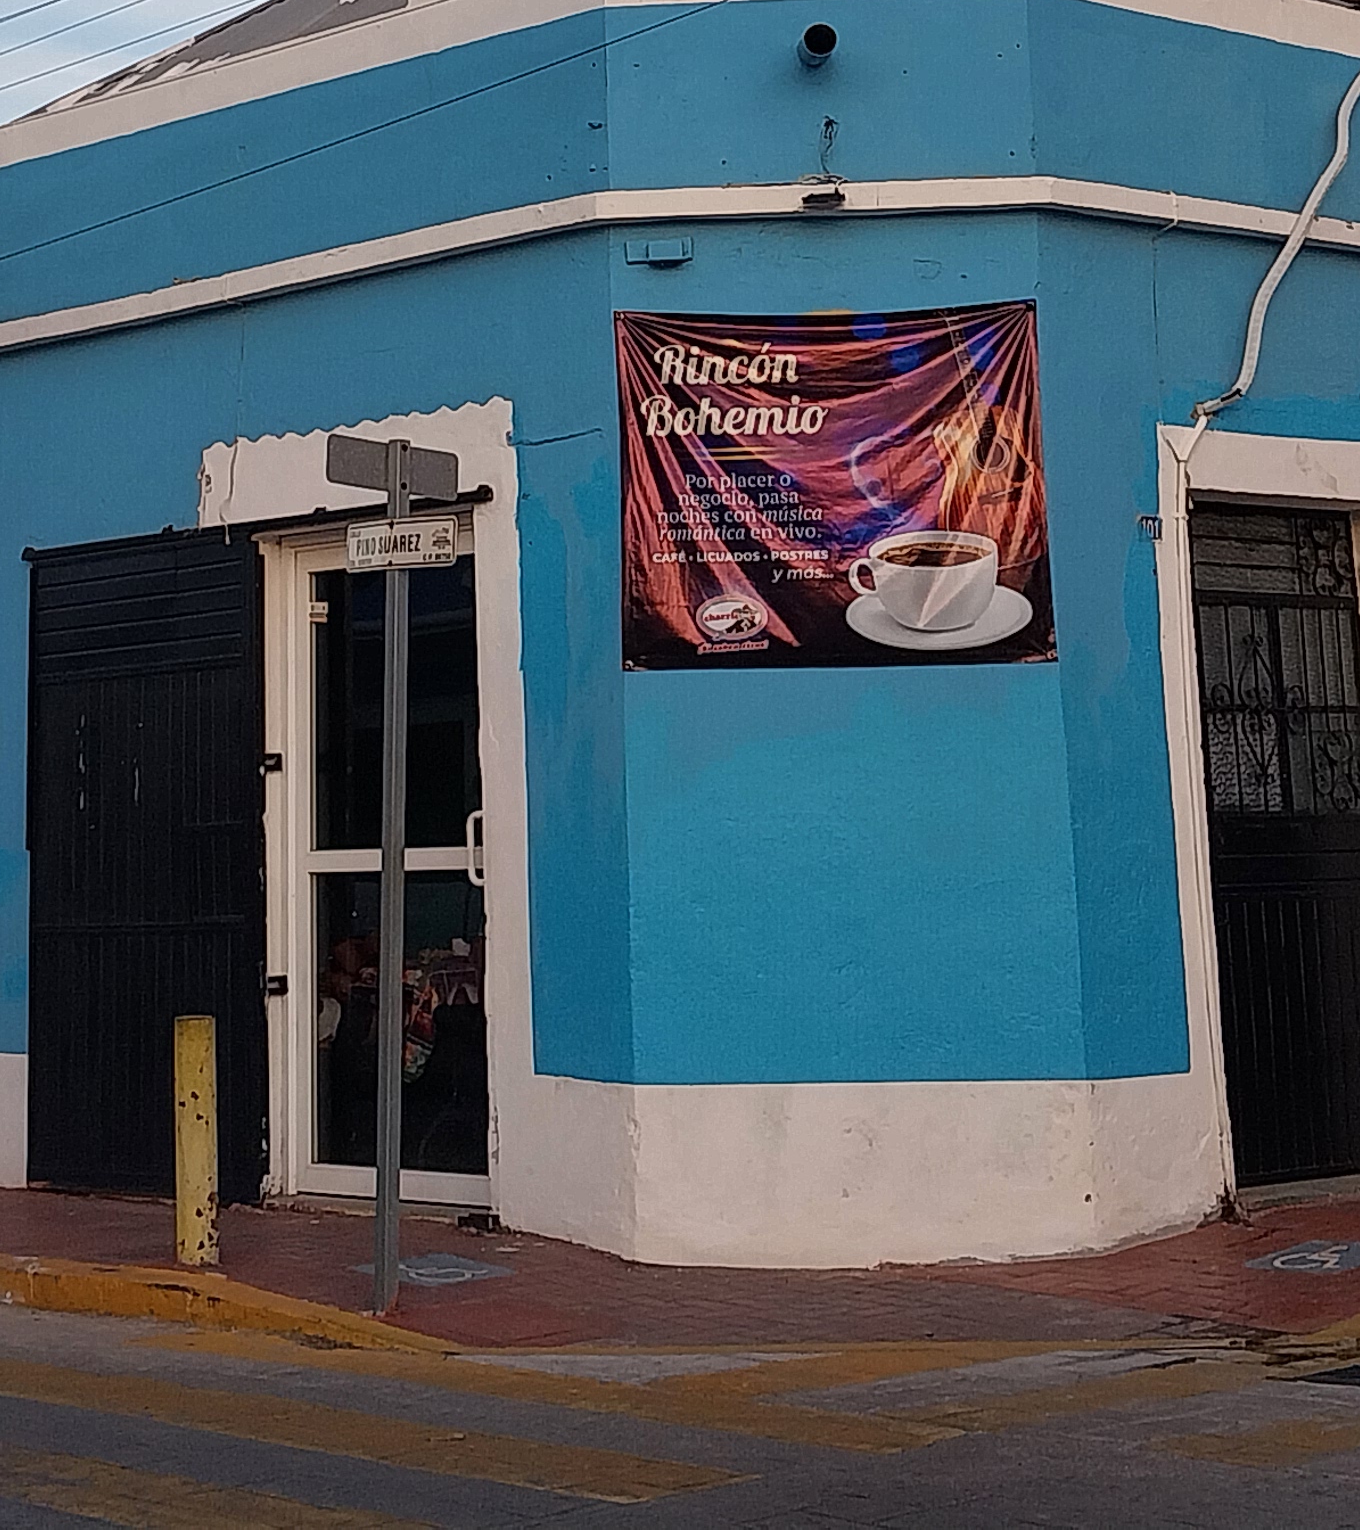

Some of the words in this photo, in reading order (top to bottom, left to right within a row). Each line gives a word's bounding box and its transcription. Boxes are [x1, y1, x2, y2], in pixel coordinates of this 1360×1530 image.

[653, 342, 799, 385] Rincón
[640, 394, 829, 437] Bohemio
[685, 473, 714, 489] Por
[720, 472, 774, 492] placer
[779, 473, 791, 486] o
[678, 490, 754, 509] negocio,
[759, 491, 799, 508] pasa
[657, 506, 720, 524] noches
[724, 509, 757, 523] con
[761, 505, 823, 522] música
[659, 524, 746, 542] romántica
[750, 526, 773, 540] en
[776, 523, 822, 540] vivo.
[652, 548, 686, 564] CAFÉ
[696, 551, 761, 563] LICUADOS
[770, 549, 829, 562] POSTRES
[771, 568, 783, 584] y
